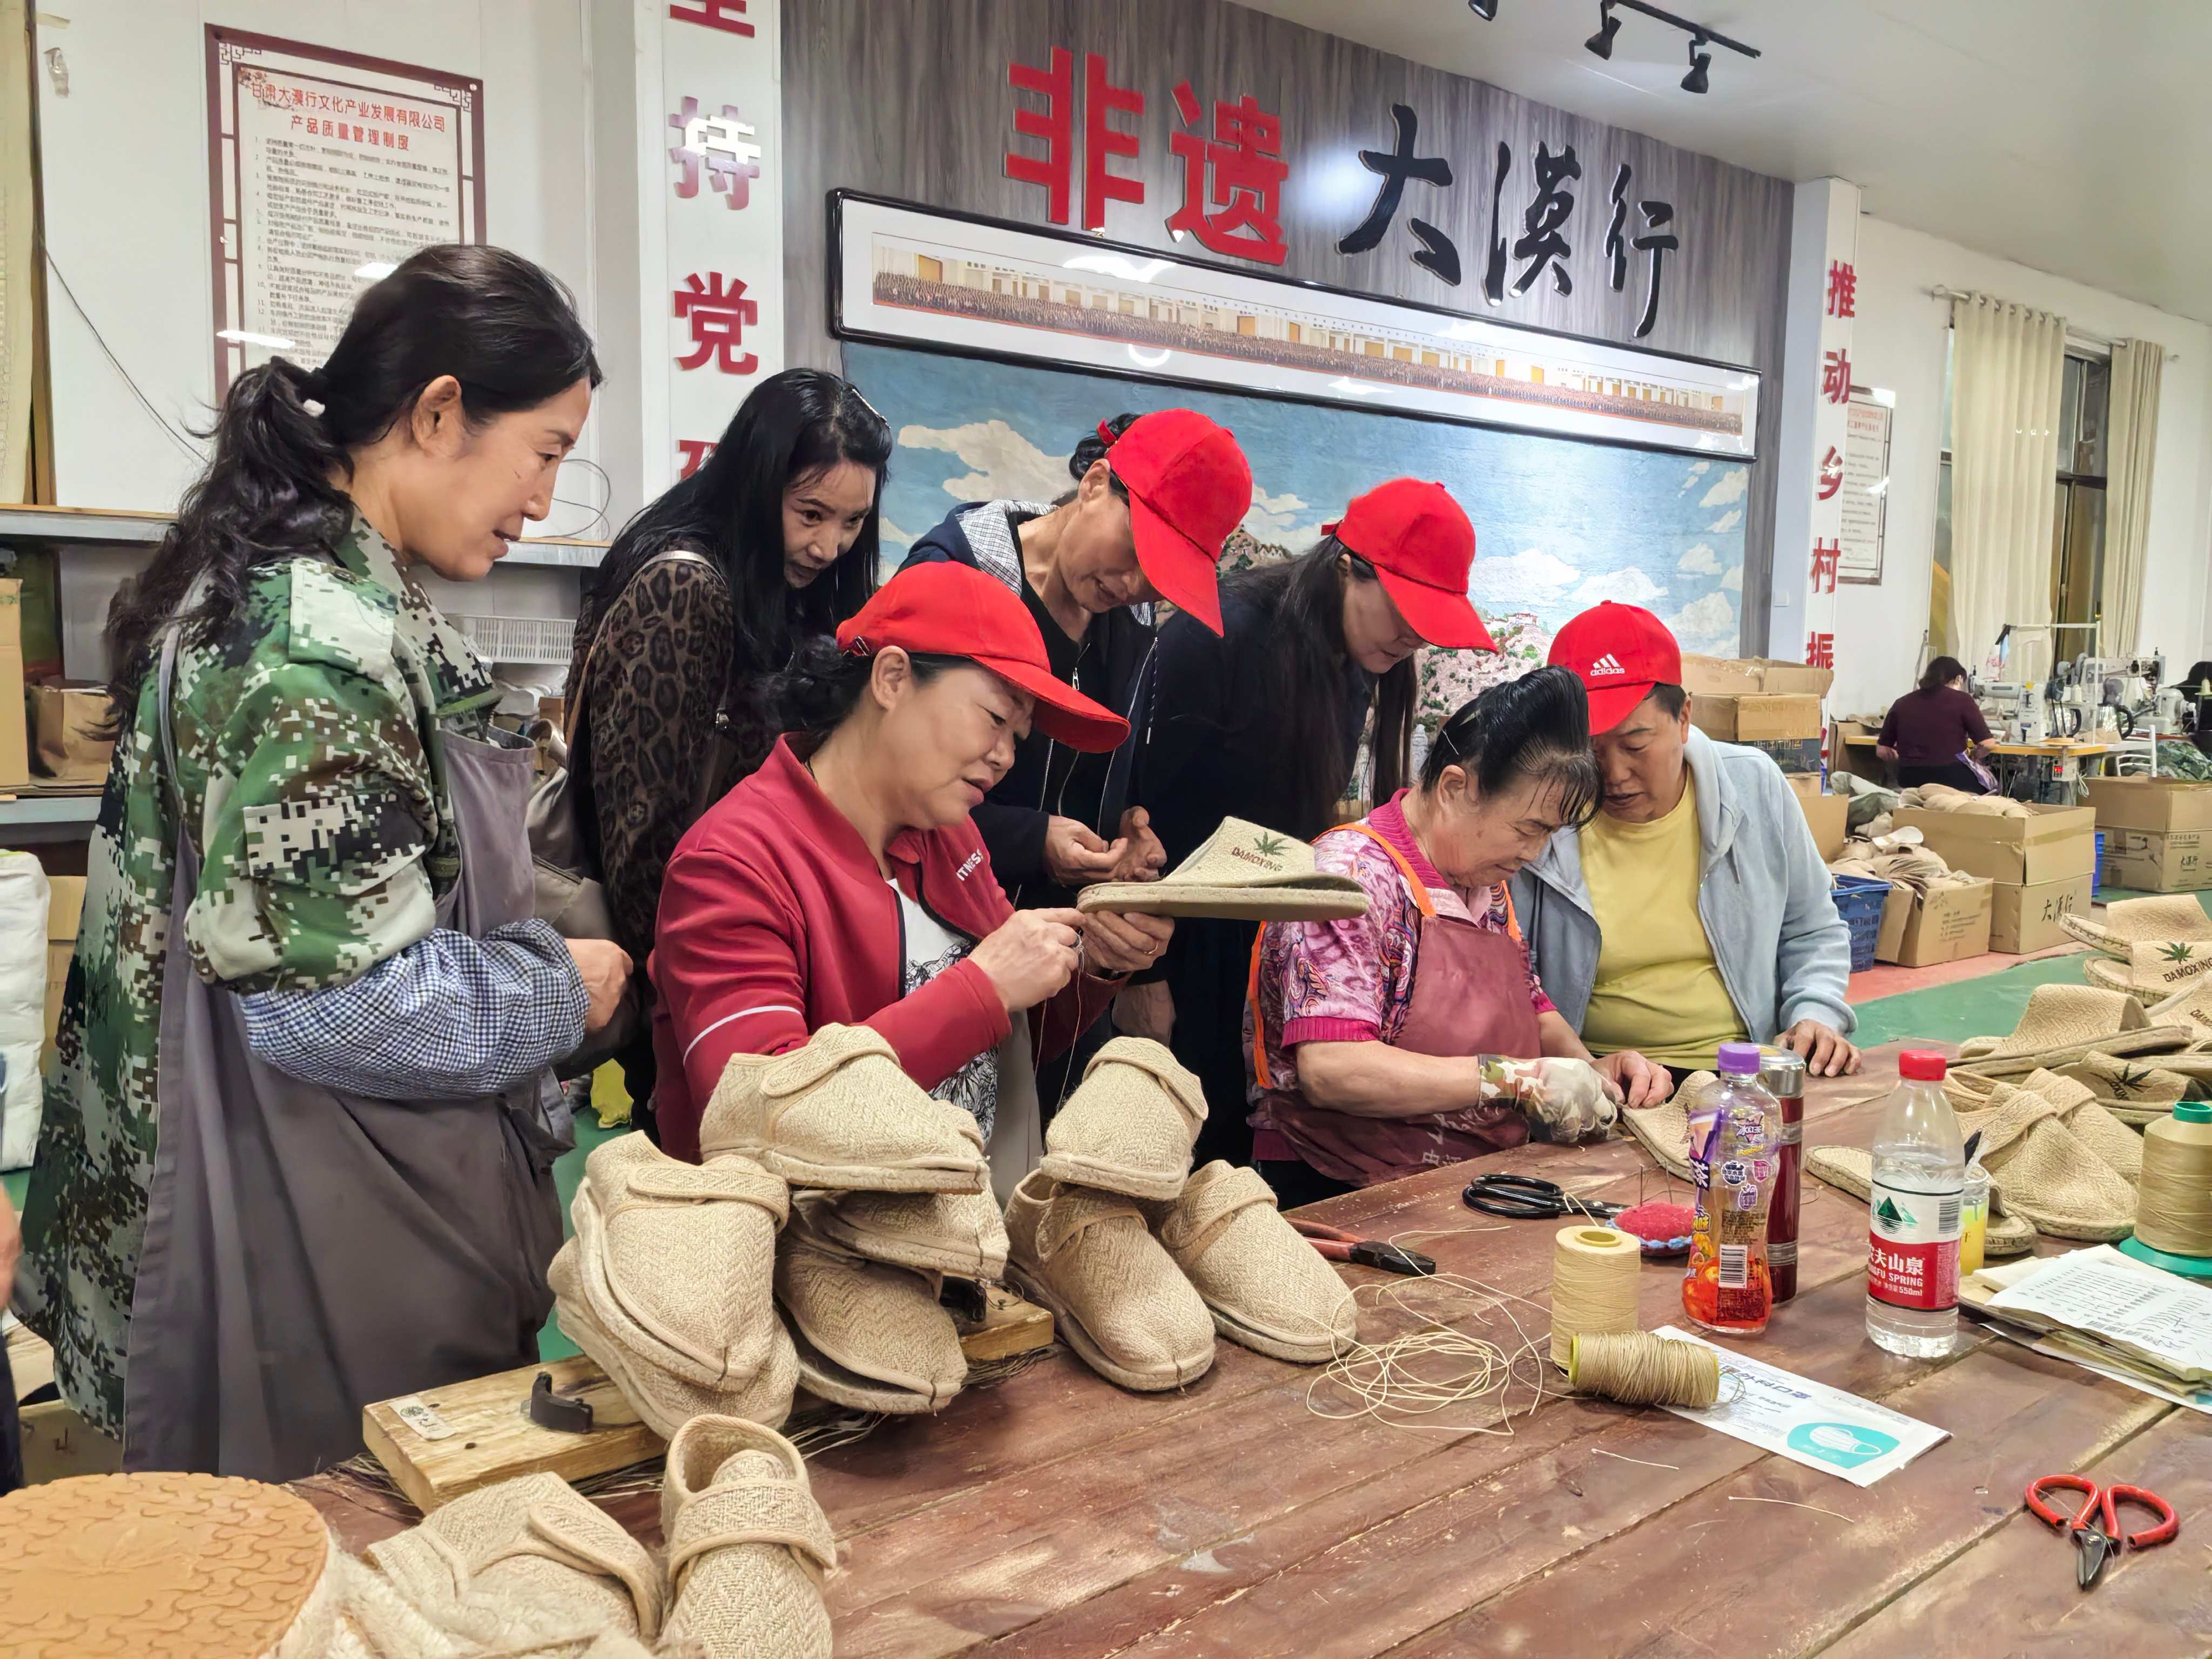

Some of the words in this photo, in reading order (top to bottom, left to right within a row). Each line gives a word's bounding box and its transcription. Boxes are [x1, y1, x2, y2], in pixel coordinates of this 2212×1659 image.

[291, 115, 410, 151] 产品质量管理制度
[1003, 45, 1289, 265] 非遗
[1590, 667, 1625, 676] adidas
[1888, 1272, 1923, 1287] SPRING
